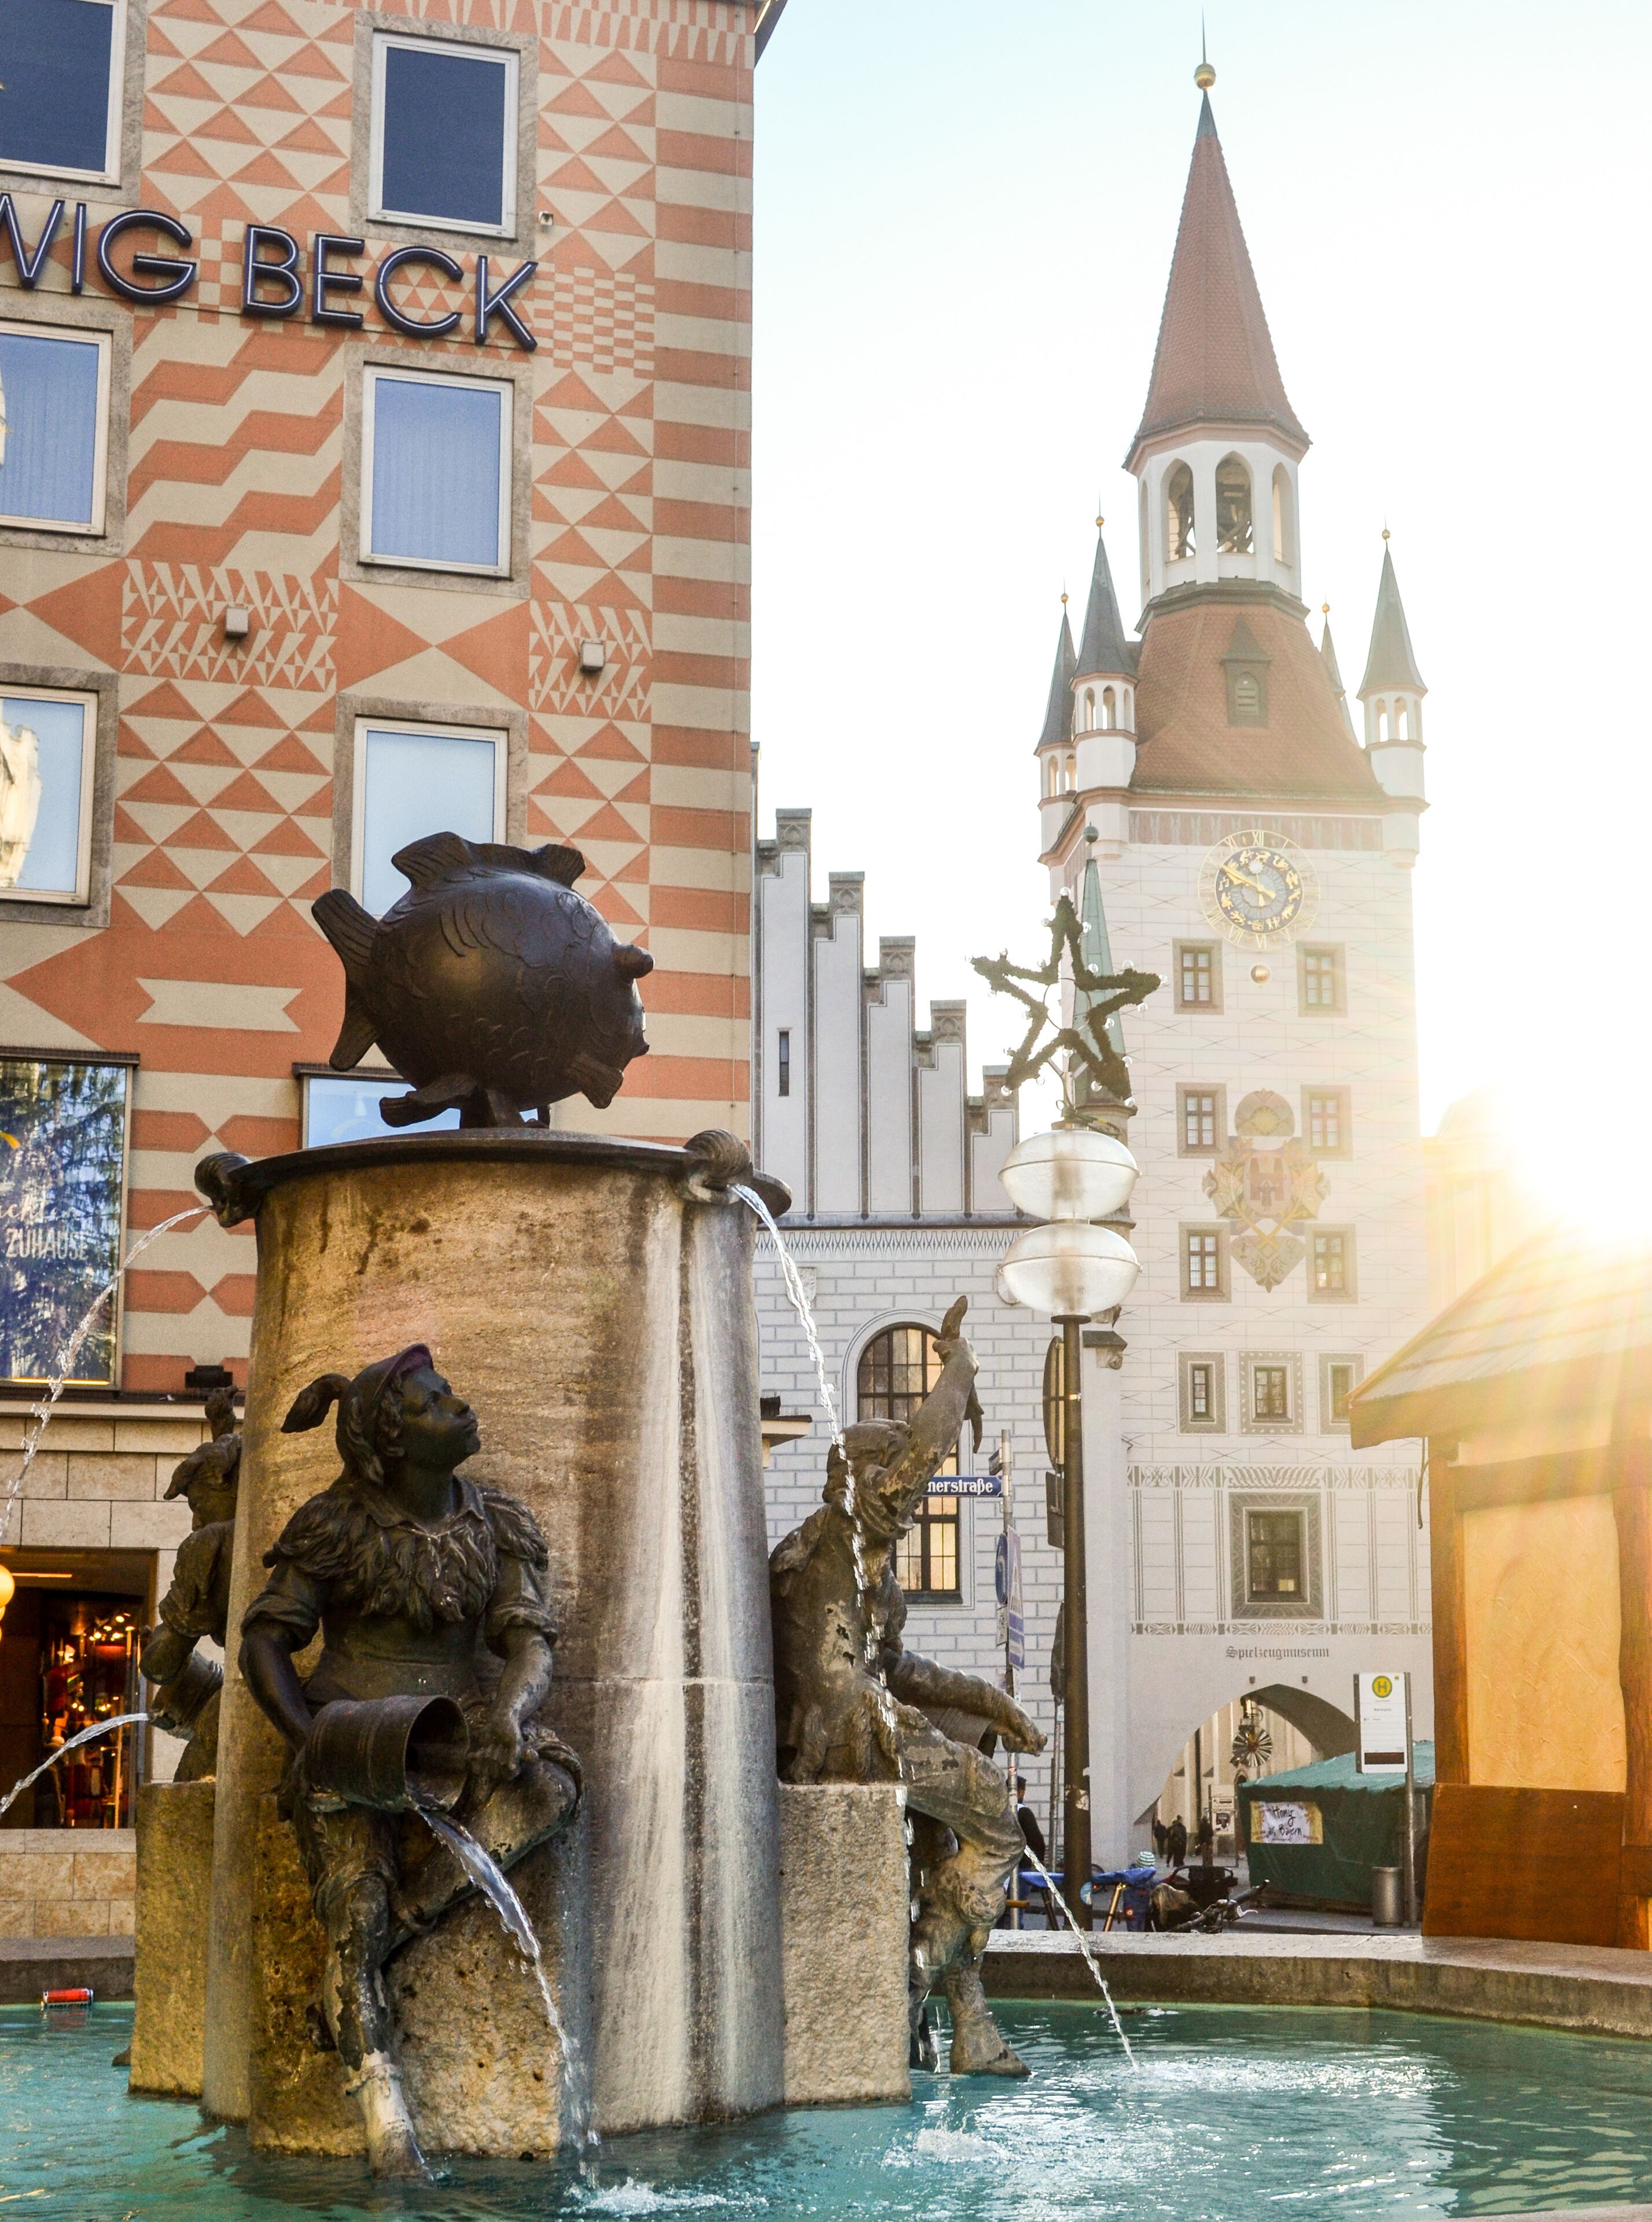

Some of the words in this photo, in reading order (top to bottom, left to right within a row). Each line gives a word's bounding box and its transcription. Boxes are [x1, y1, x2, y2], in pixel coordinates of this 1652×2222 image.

[242, 224, 538, 351] BECK
[6, 1227, 89, 1260] ZUHAUSE
[1226, 1646, 1330, 1660] Spielzeugmuseum
[1272, 1804, 1296, 1827] Honig
